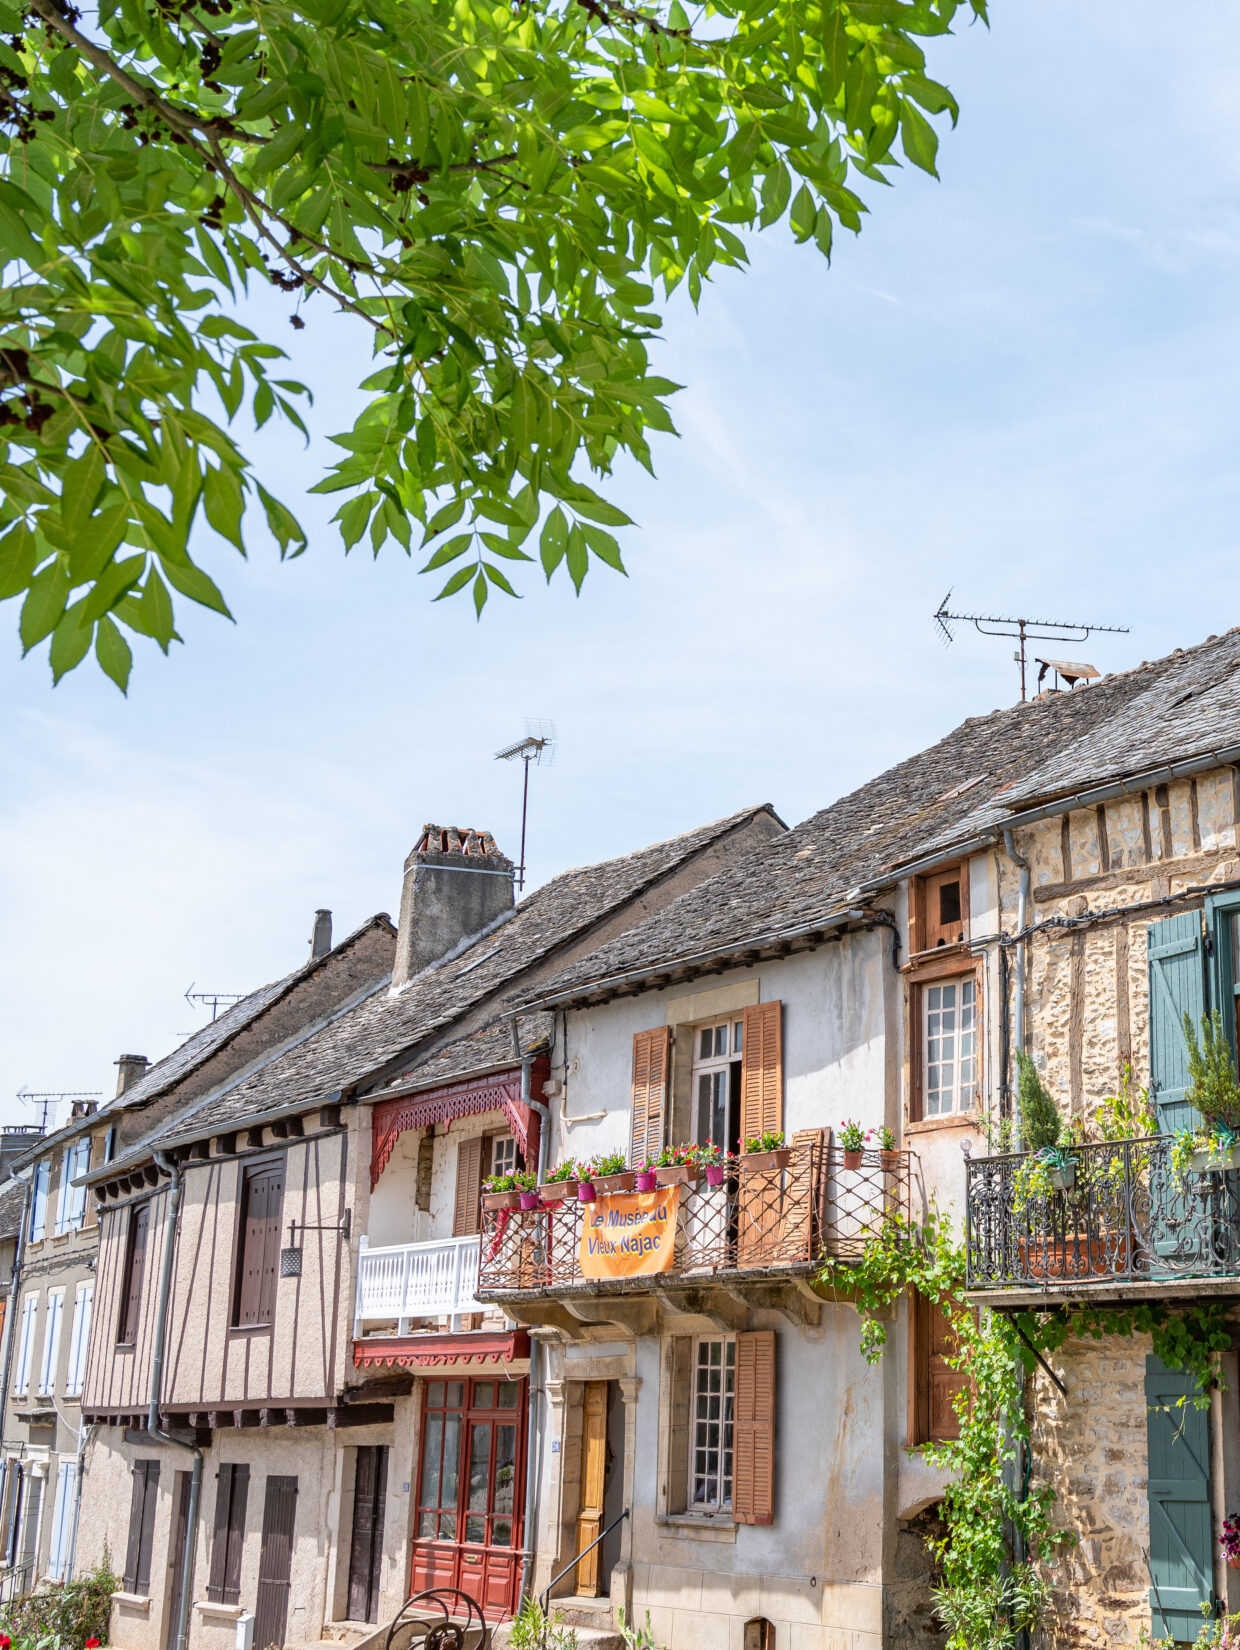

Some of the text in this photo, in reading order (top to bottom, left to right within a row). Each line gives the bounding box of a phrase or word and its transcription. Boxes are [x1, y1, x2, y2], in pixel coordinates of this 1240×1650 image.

[590, 1209, 605, 1228] Le
[588, 1233, 661, 1256] Vieux Najac
